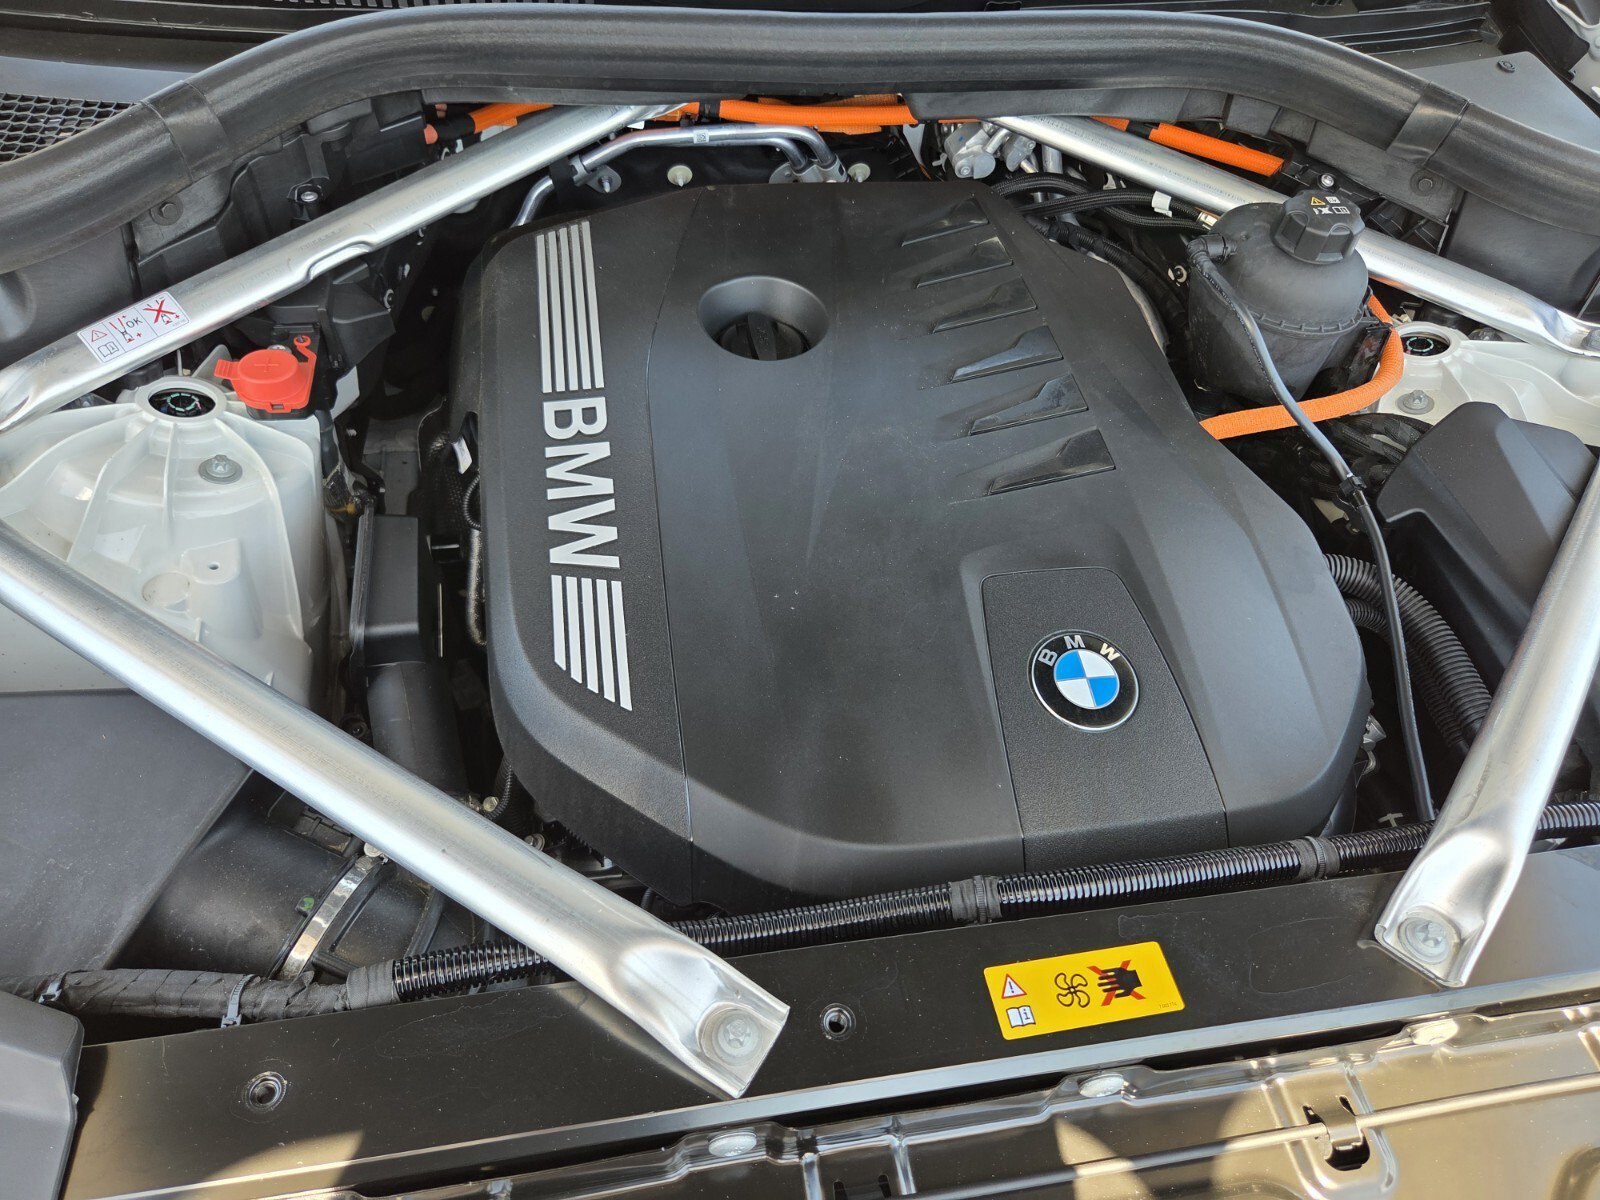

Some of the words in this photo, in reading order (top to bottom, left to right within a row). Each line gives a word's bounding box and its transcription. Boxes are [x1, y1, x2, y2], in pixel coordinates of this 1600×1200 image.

[126, 317, 143, 328] OK
[543, 397, 620, 569] BMW
[1038, 635, 1120, 667] BMW
